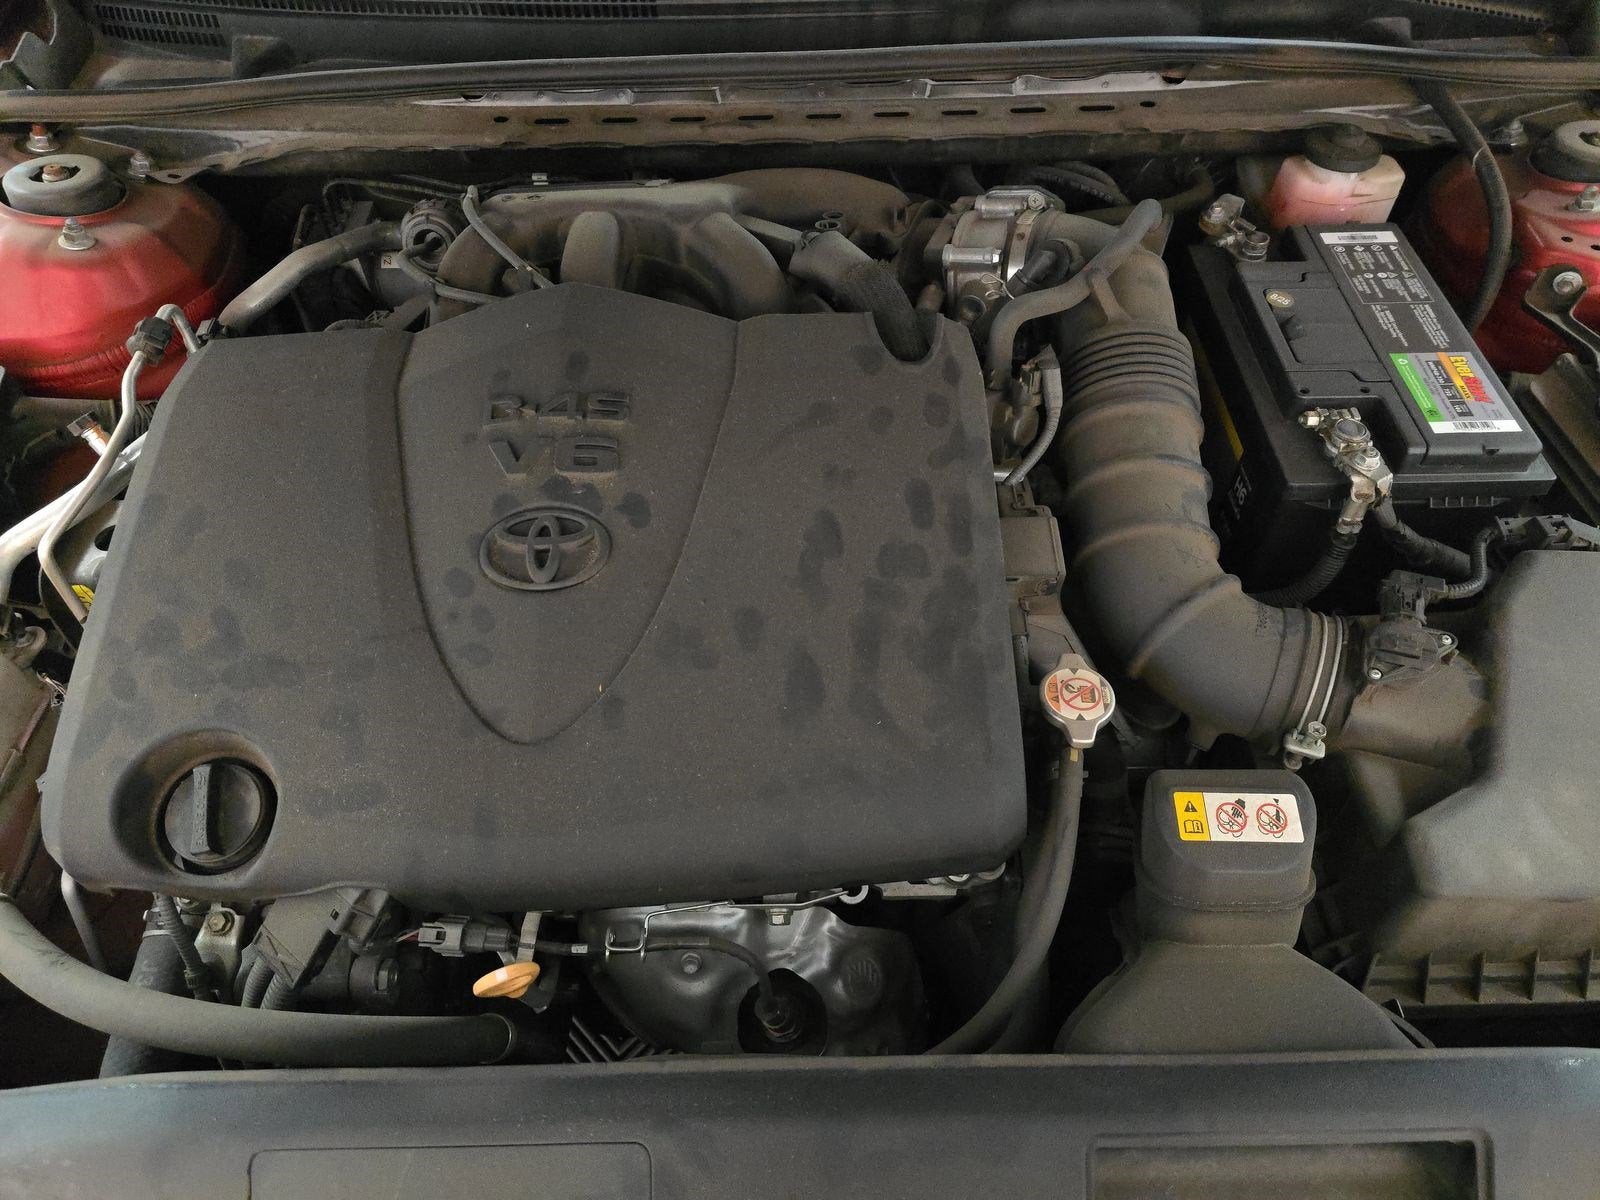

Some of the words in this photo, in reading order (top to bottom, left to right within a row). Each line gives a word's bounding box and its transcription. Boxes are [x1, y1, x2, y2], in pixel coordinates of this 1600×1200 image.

[1448, 355, 1495, 405] EverStart
[1459, 385, 1471, 399] MAXX
[488, 434, 619, 475] V6
[1233, 475, 1248, 506] H6
